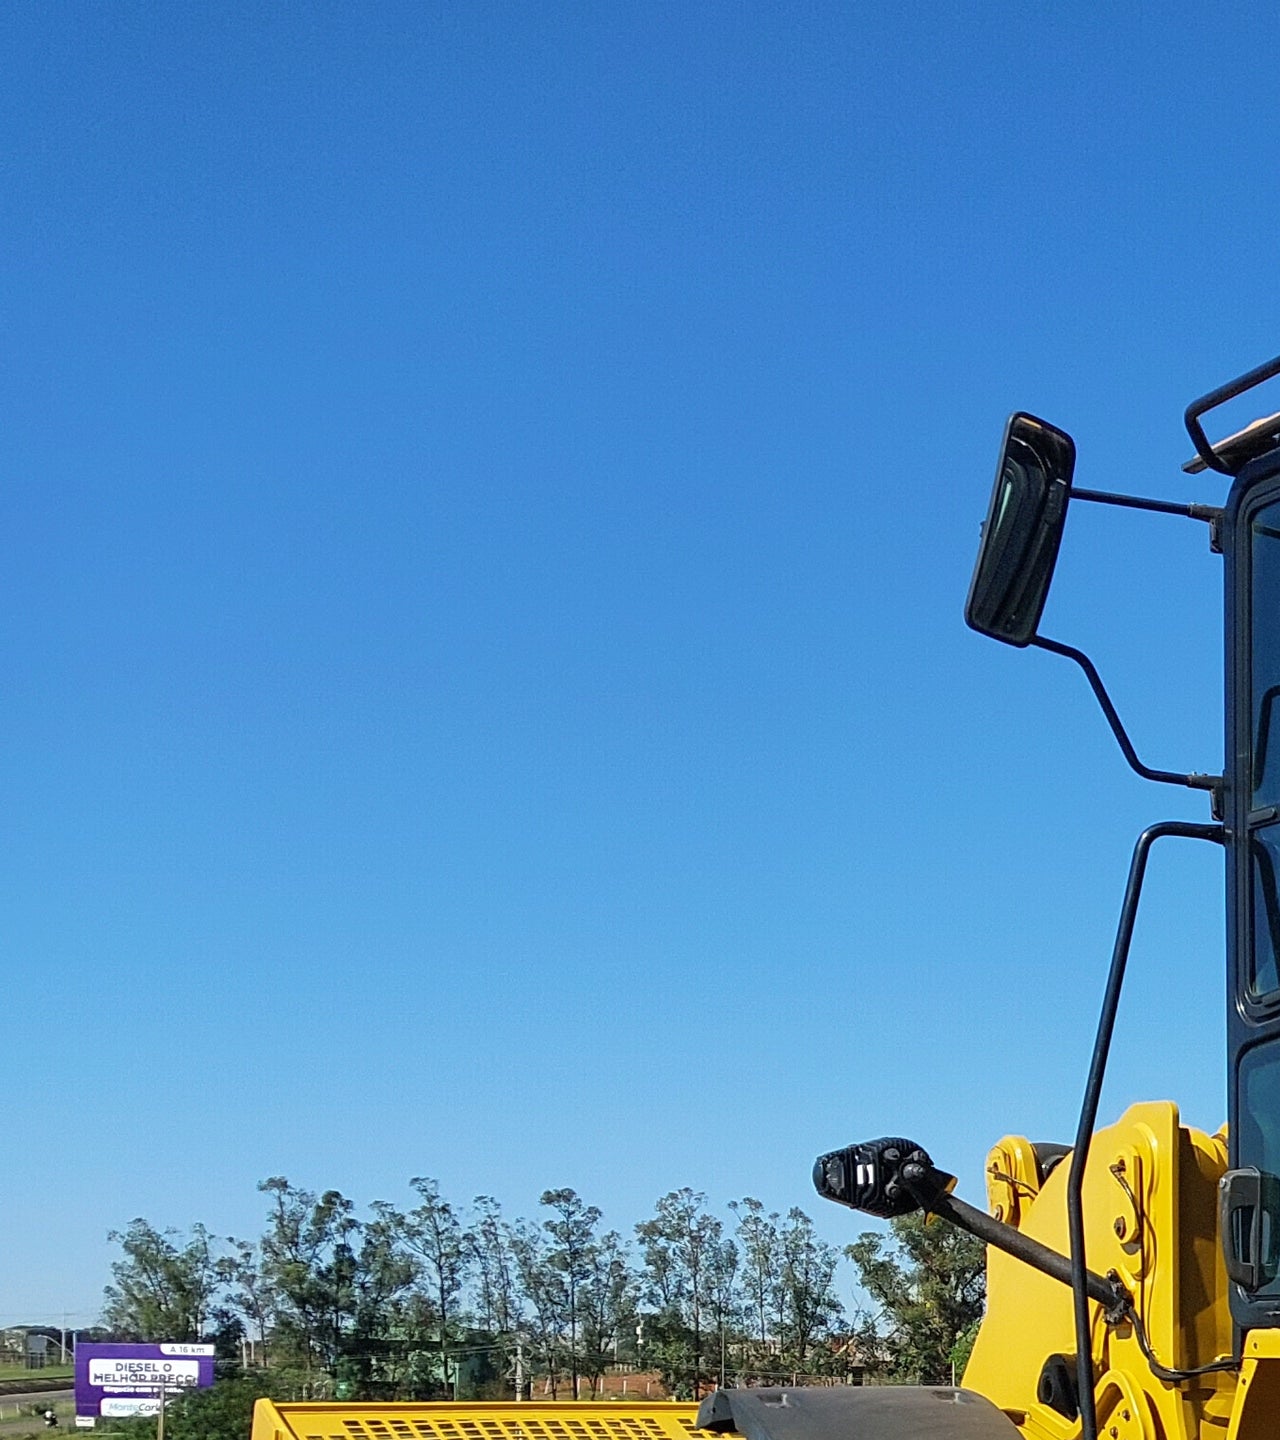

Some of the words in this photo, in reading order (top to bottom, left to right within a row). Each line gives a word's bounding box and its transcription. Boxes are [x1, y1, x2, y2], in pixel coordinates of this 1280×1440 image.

[115, 1362, 159, 1373] DIESEL
[163, 1363, 172, 1372] O
[93, 1373, 147, 1383] MELHOR
